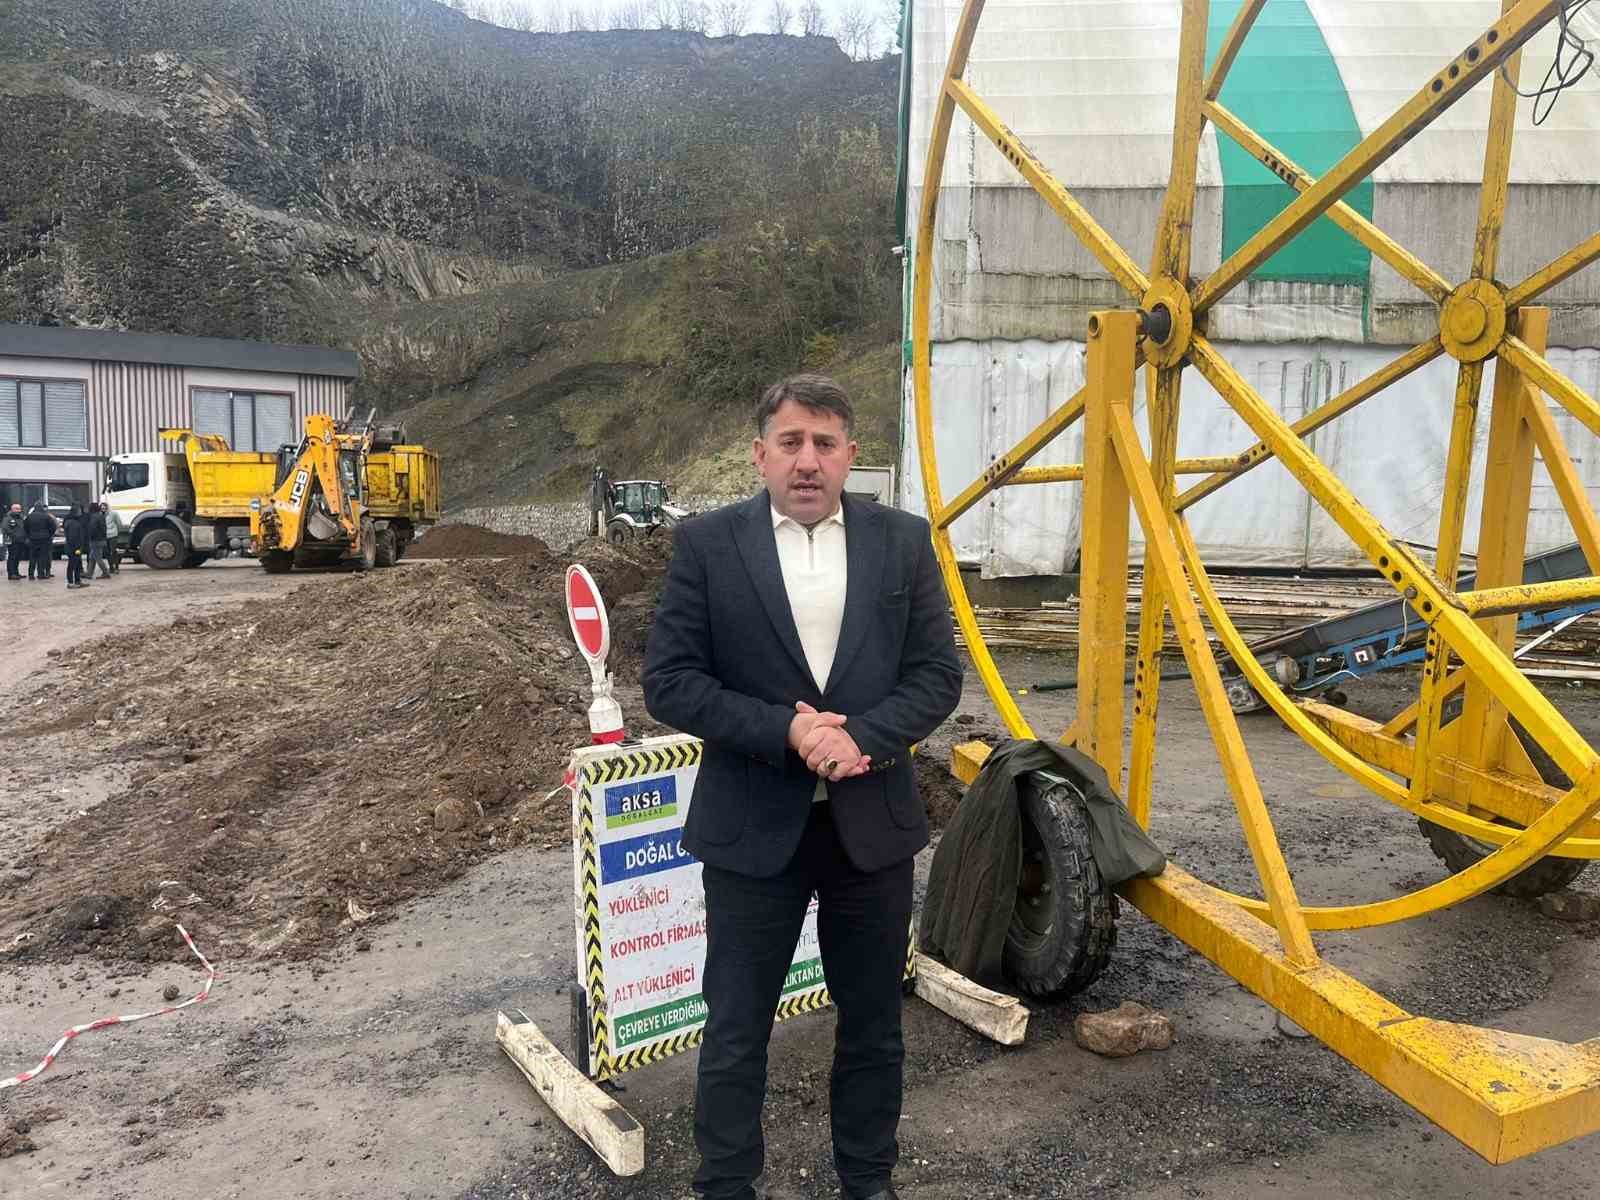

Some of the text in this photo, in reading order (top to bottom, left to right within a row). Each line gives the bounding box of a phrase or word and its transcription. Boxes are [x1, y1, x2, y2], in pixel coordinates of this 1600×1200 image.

[290, 471, 308, 509] JCB
[622, 789, 661, 813] aksa
[625, 840, 690, 870] DOĞAL G
[608, 884, 669, 917] YÜKLENİCİ
[610, 931, 666, 959] KONTROL
[614, 962, 695, 1003] ALT YÜKLENİCİ
[618, 1014, 660, 1045] ÇEVREYE
